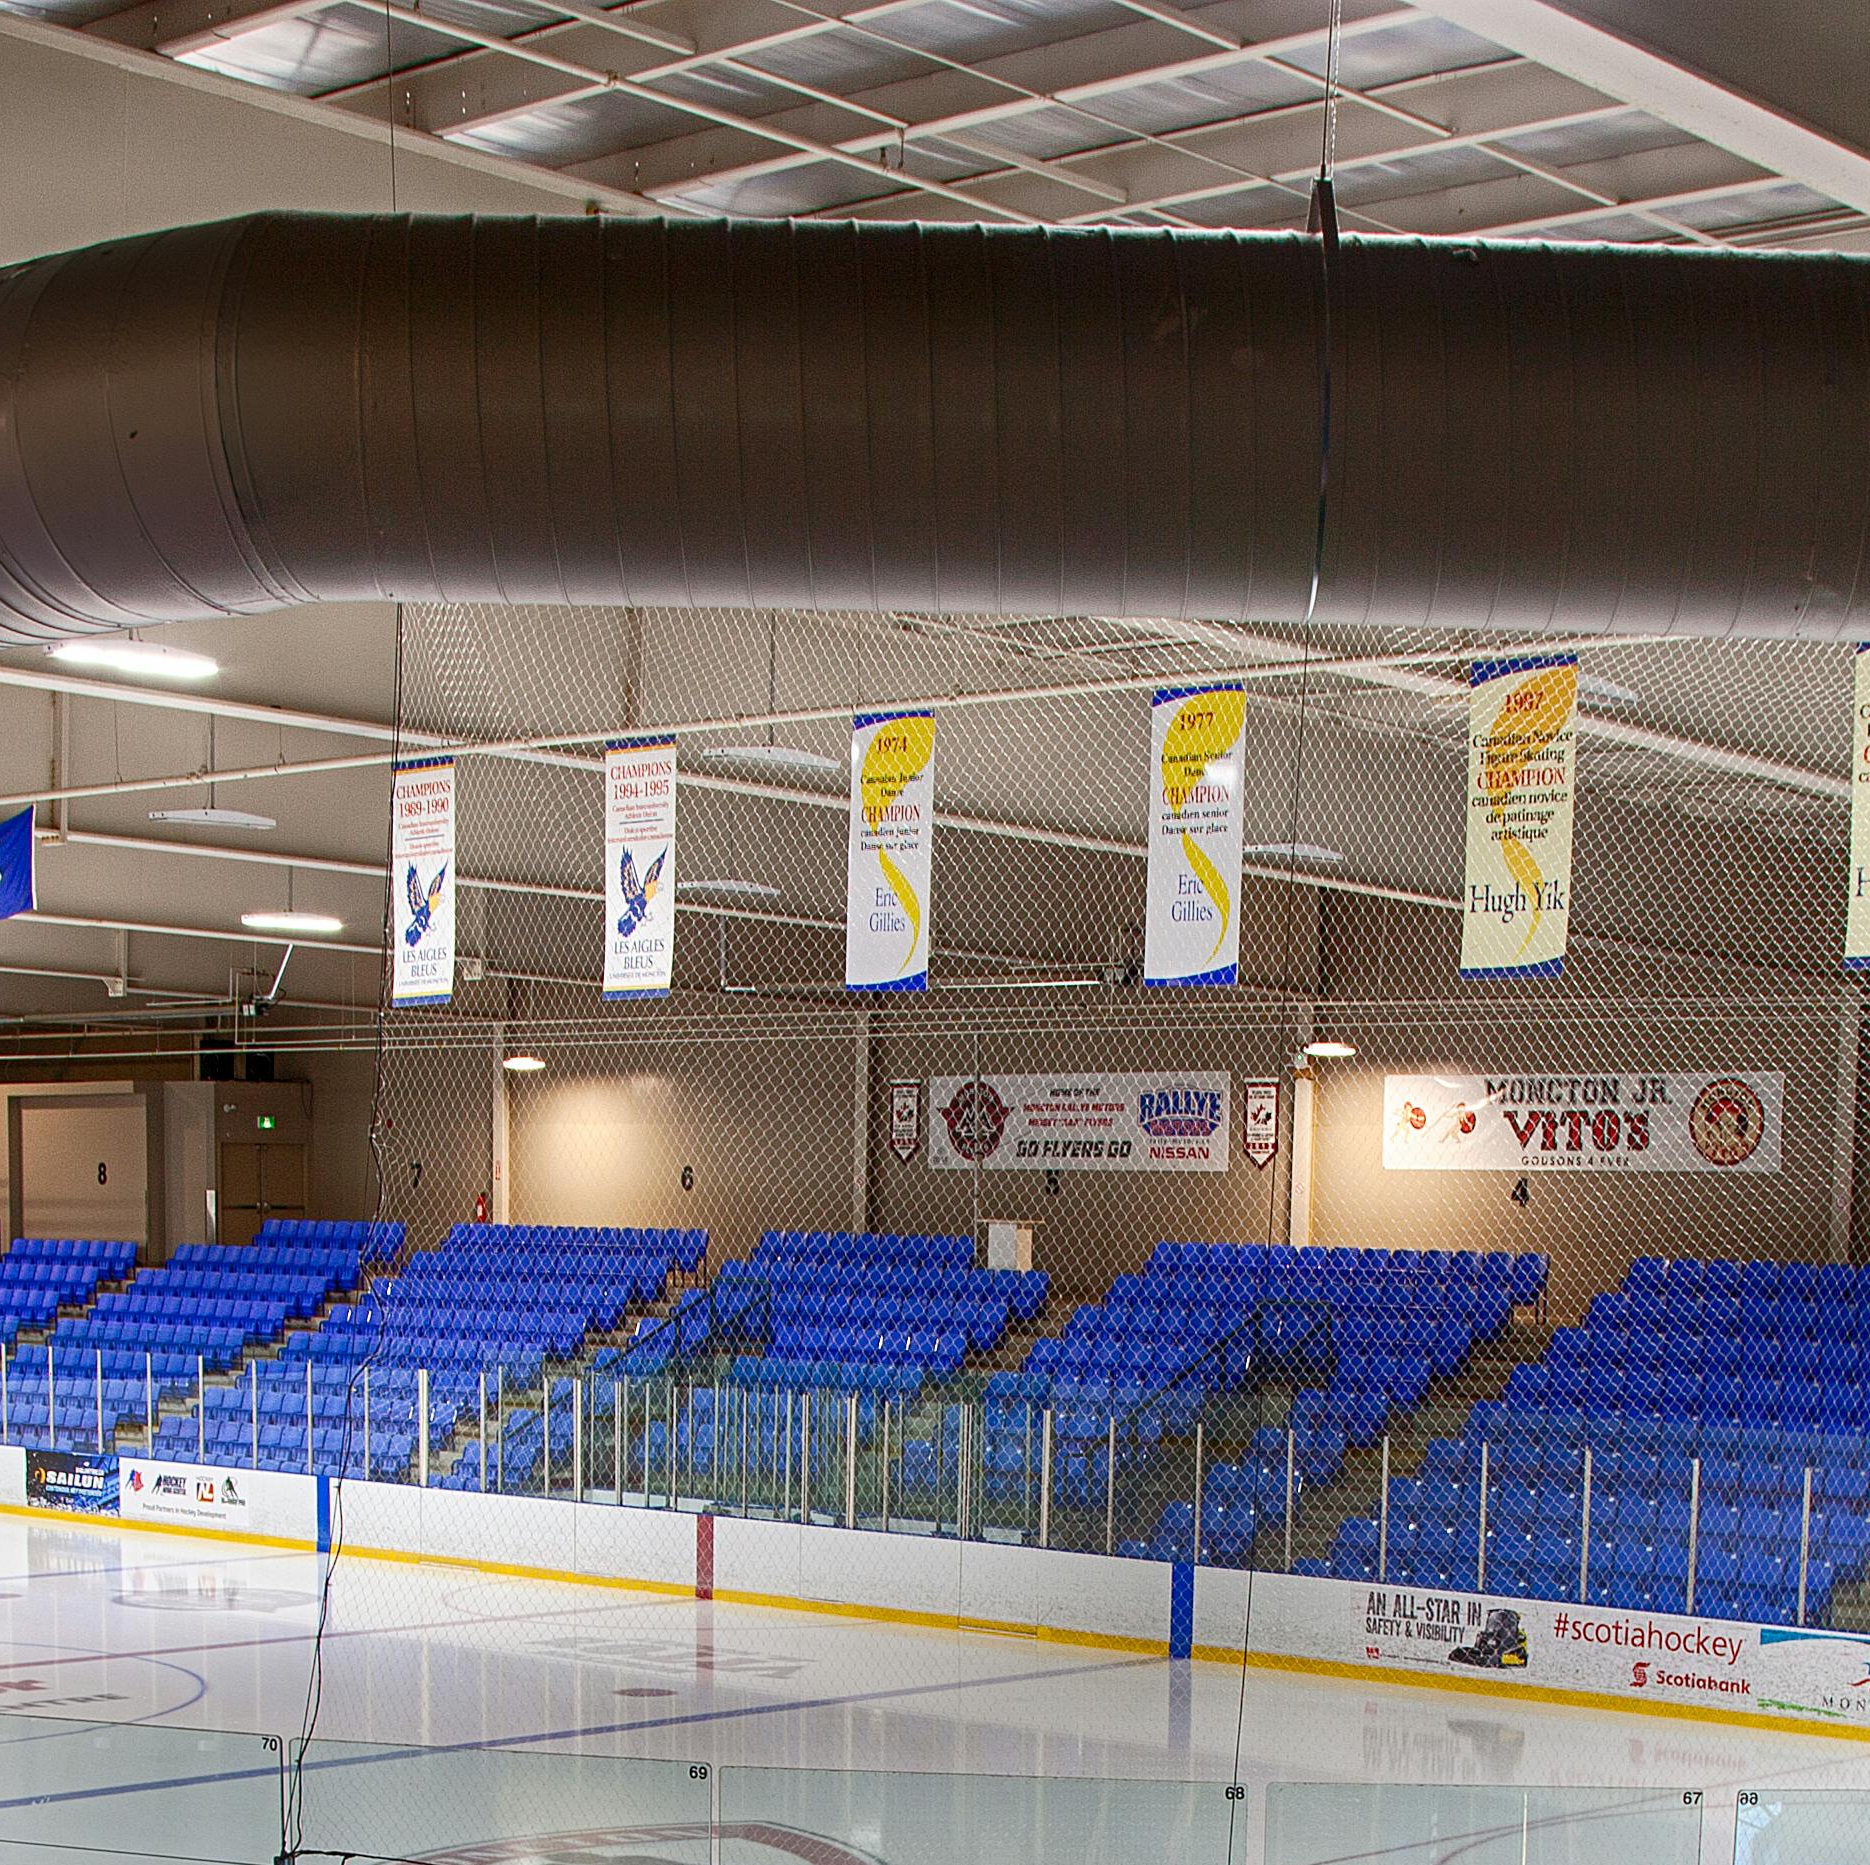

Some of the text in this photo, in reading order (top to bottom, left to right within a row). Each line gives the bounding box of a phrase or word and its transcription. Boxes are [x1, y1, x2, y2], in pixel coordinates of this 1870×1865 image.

[1179, 711, 1215, 731] 1977
[876, 736, 908, 755] 1974
[1533, 729, 1574, 744] Novice
[1161, 750, 1233, 764] Canadian Senior
[610, 760, 672, 781] CHAMPIONS
[1477, 767, 1566, 790] CHAMPION
[396, 779, 451, 800] CHAMPIONS
[613, 779, 670, 800] 1994-1995
[1161, 784, 1231, 806] CHAMPION
[1471, 790, 1568, 808] canadien novice
[399, 797, 450, 818] 1989-1990
[861, 803, 920, 824] CHAMPION
[1161, 808, 1230, 821] canadien senior
[1485, 809, 1555, 828] de patinage
[1190, 824, 1228, 836] sur glace
[1490, 826, 1548, 844] artistique
[1178, 873, 1204, 896] Eric
[875, 886, 898, 907] Eric
[1469, 879, 1565, 924] Hugh Yik
[1171, 900, 1213, 923] Gillies
[869, 912, 906, 933] Gillies
[402, 947, 447, 964] LES AIGLES
[614, 938, 665, 955] LES AIGLES
[410, 964, 438, 978] BLEUS
[623, 955, 654, 970] BLEUS
[1484, 1077, 1673, 1105] MONCTON JR.
[1139, 1089, 1223, 1124] RALLYE
[1016, 1140, 1133, 1158] GO FLYERS GO
[1150, 1146, 1210, 1160] NISSAN
[97, 1162, 108, 1186] 8
[410, 1161, 422, 1189] 7
[681, 1165, 694, 1191] 6
[1511, 1177, 1530, 1207] 4
[46, 1471, 105, 1489] SAILUN
[142, 1503, 158, 1512] Proud
[1366, 1591, 1481, 1627] AN ALL-STAR IN
[1365, 1617, 1466, 1644] SAFETY & VISIBILITY
[1553, 1612, 1744, 1666] #scotiahockey
[1655, 1669, 1751, 1695] Scotiabank
[262, 1736, 278, 1752] 70
[689, 1765, 707, 1780] 69
[1225, 1786, 1245, 1801] 68
[1682, 1791, 1703, 1805] 67
